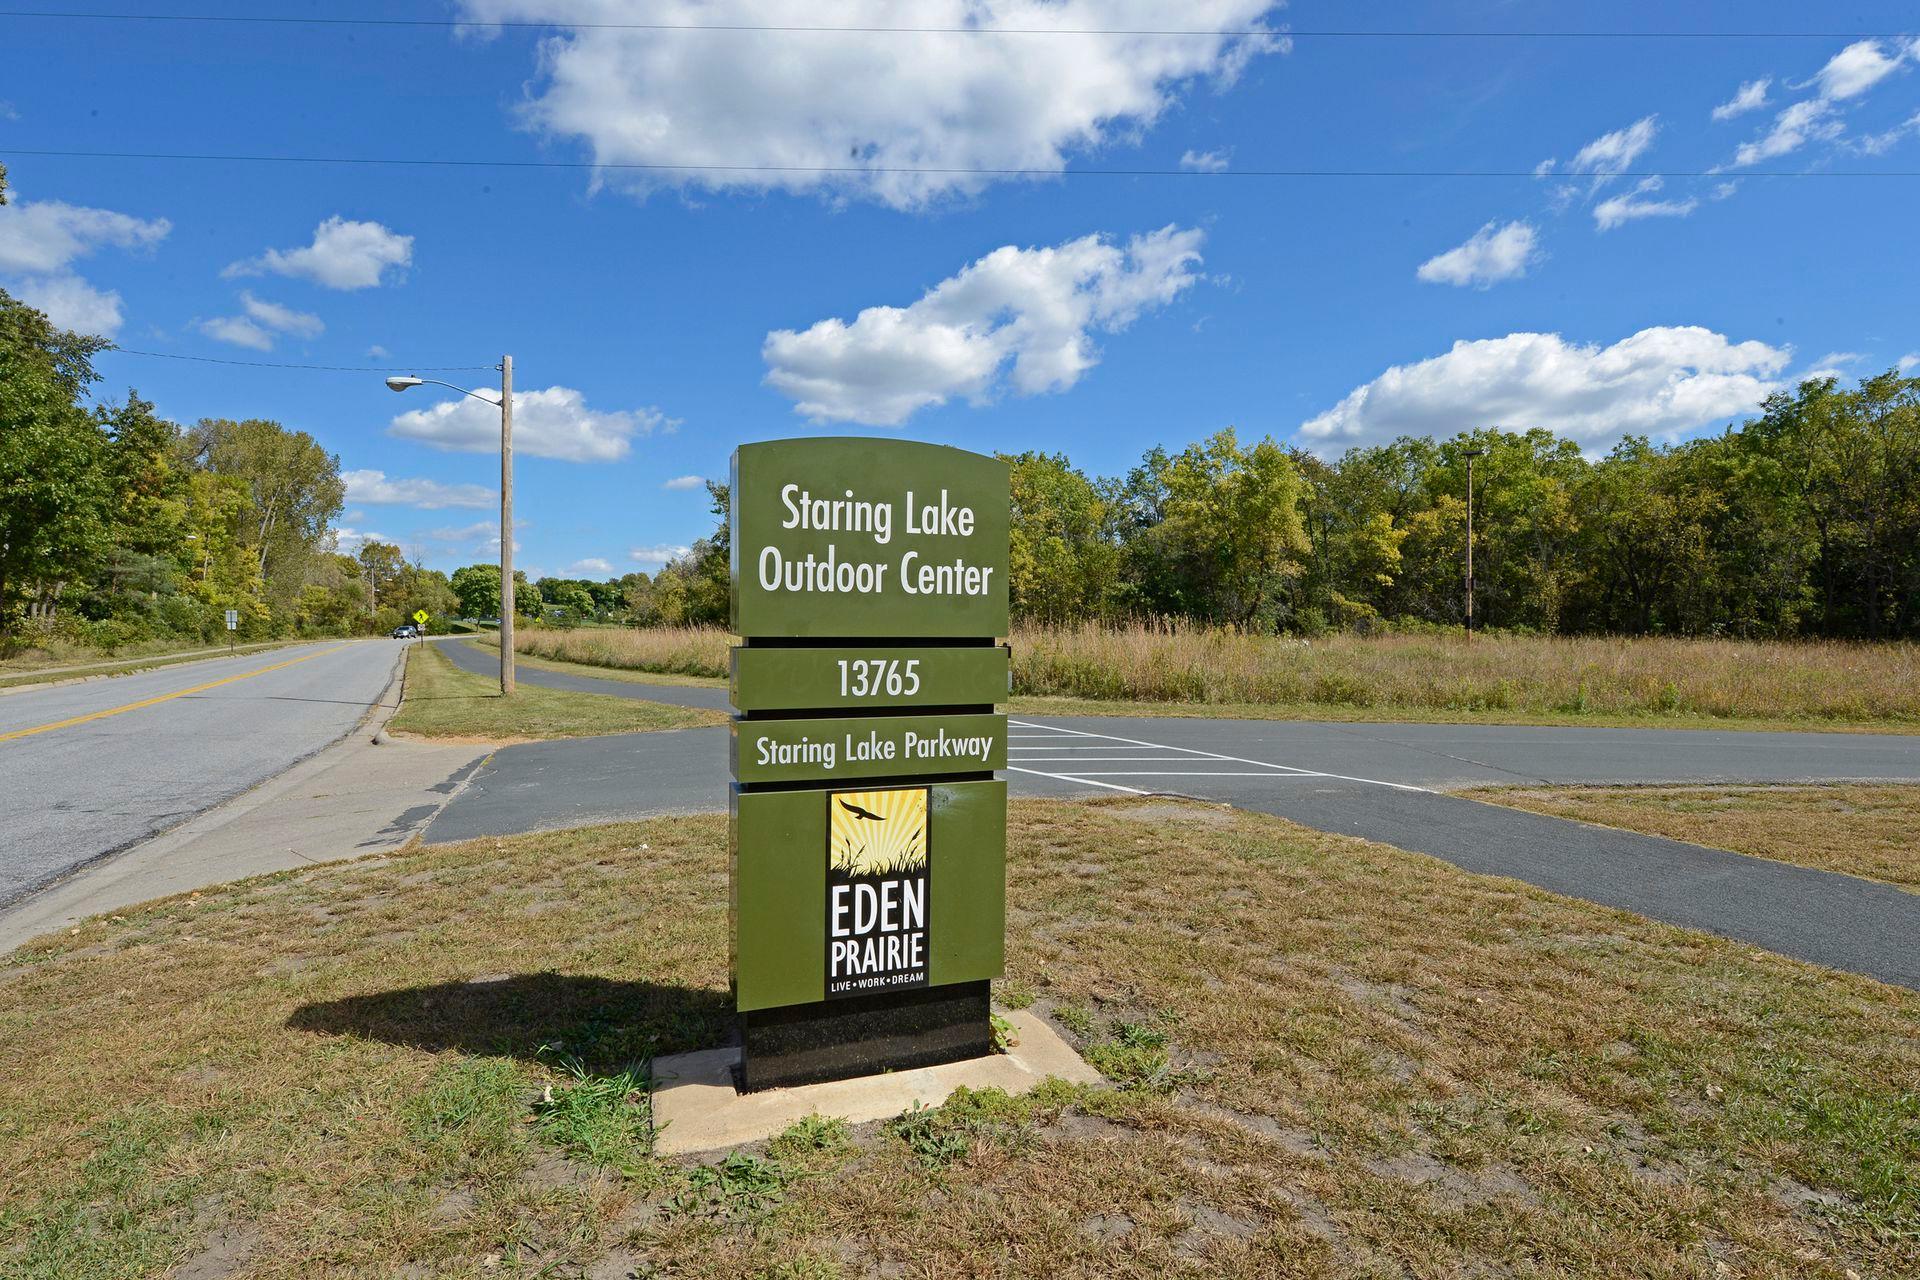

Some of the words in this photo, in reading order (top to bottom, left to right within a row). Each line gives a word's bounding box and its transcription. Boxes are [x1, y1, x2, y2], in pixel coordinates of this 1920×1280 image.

[781, 483, 892, 545] Staring
[906, 489, 975, 536] Lake
[758, 544, 888, 593] Outdoor
[900, 551, 994, 595] Center
[837, 659, 920, 697] 13765
[756, 736, 836, 769] Staring
[846, 730, 896, 761] Lake
[905, 728, 993, 762] Parkway
[831, 878, 925, 938] EDEN
[831, 932, 924, 978] PRAIRIE
[831, 980, 851, 993] LIVE
[858, 976, 886, 989] WORK
[892, 972, 924, 985] DREAM
